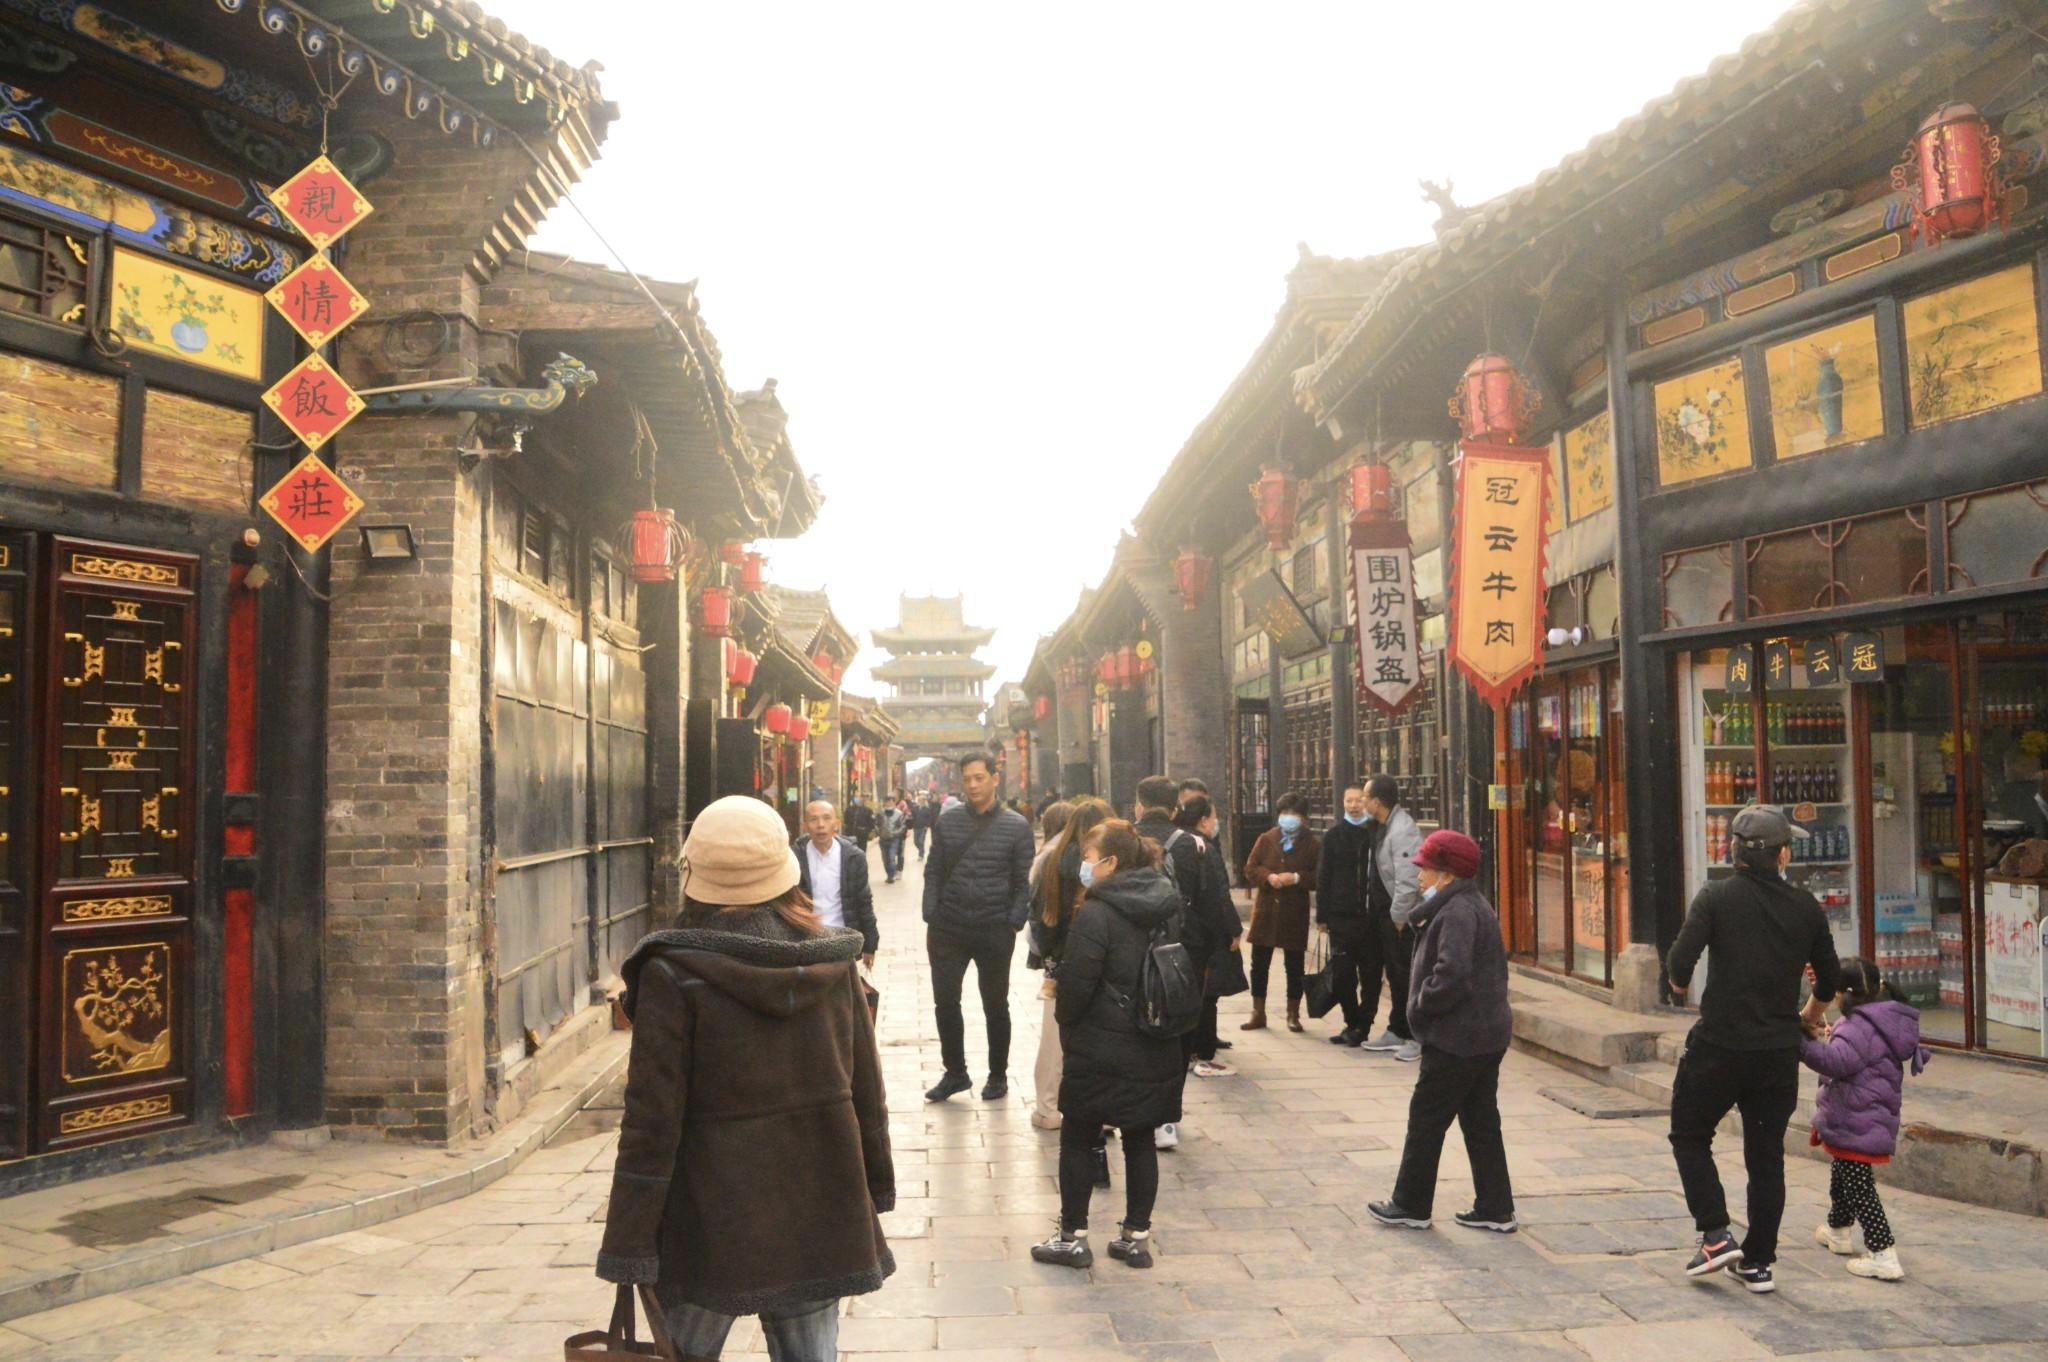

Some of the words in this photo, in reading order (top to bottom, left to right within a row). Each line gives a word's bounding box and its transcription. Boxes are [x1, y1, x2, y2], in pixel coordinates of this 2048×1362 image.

[1366, 555, 1411, 685] 围炉锅盔
[1481, 476, 1520, 647] 冠云牛肉
